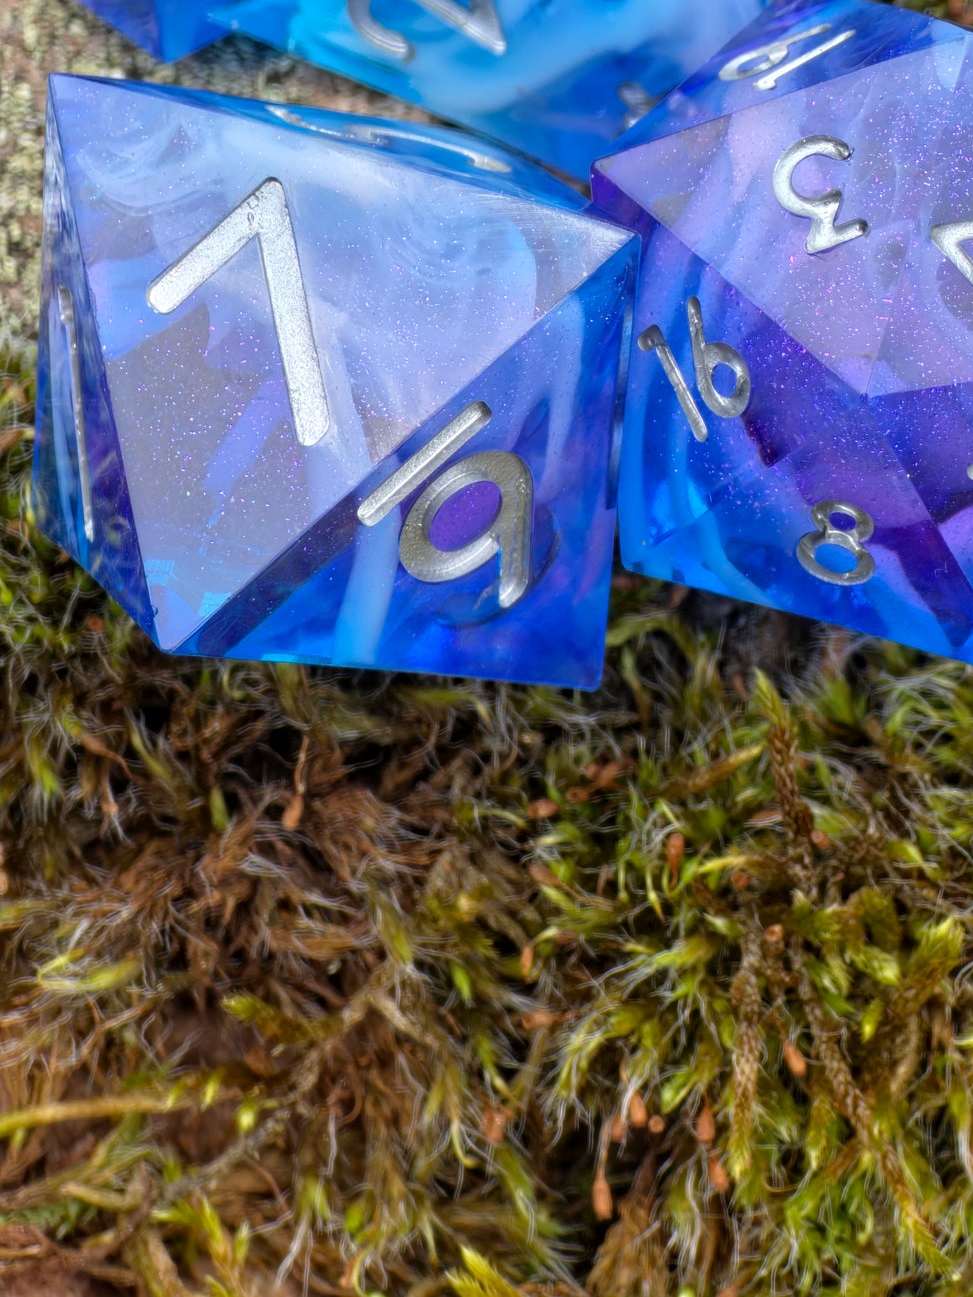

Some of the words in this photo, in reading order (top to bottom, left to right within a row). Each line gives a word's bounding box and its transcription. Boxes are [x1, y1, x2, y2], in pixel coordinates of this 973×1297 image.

[772, 134, 869, 256] 3
[145, 176, 331, 447] 7
[637, 295, 753, 444] 16
[796, 500, 876, 587] 8
